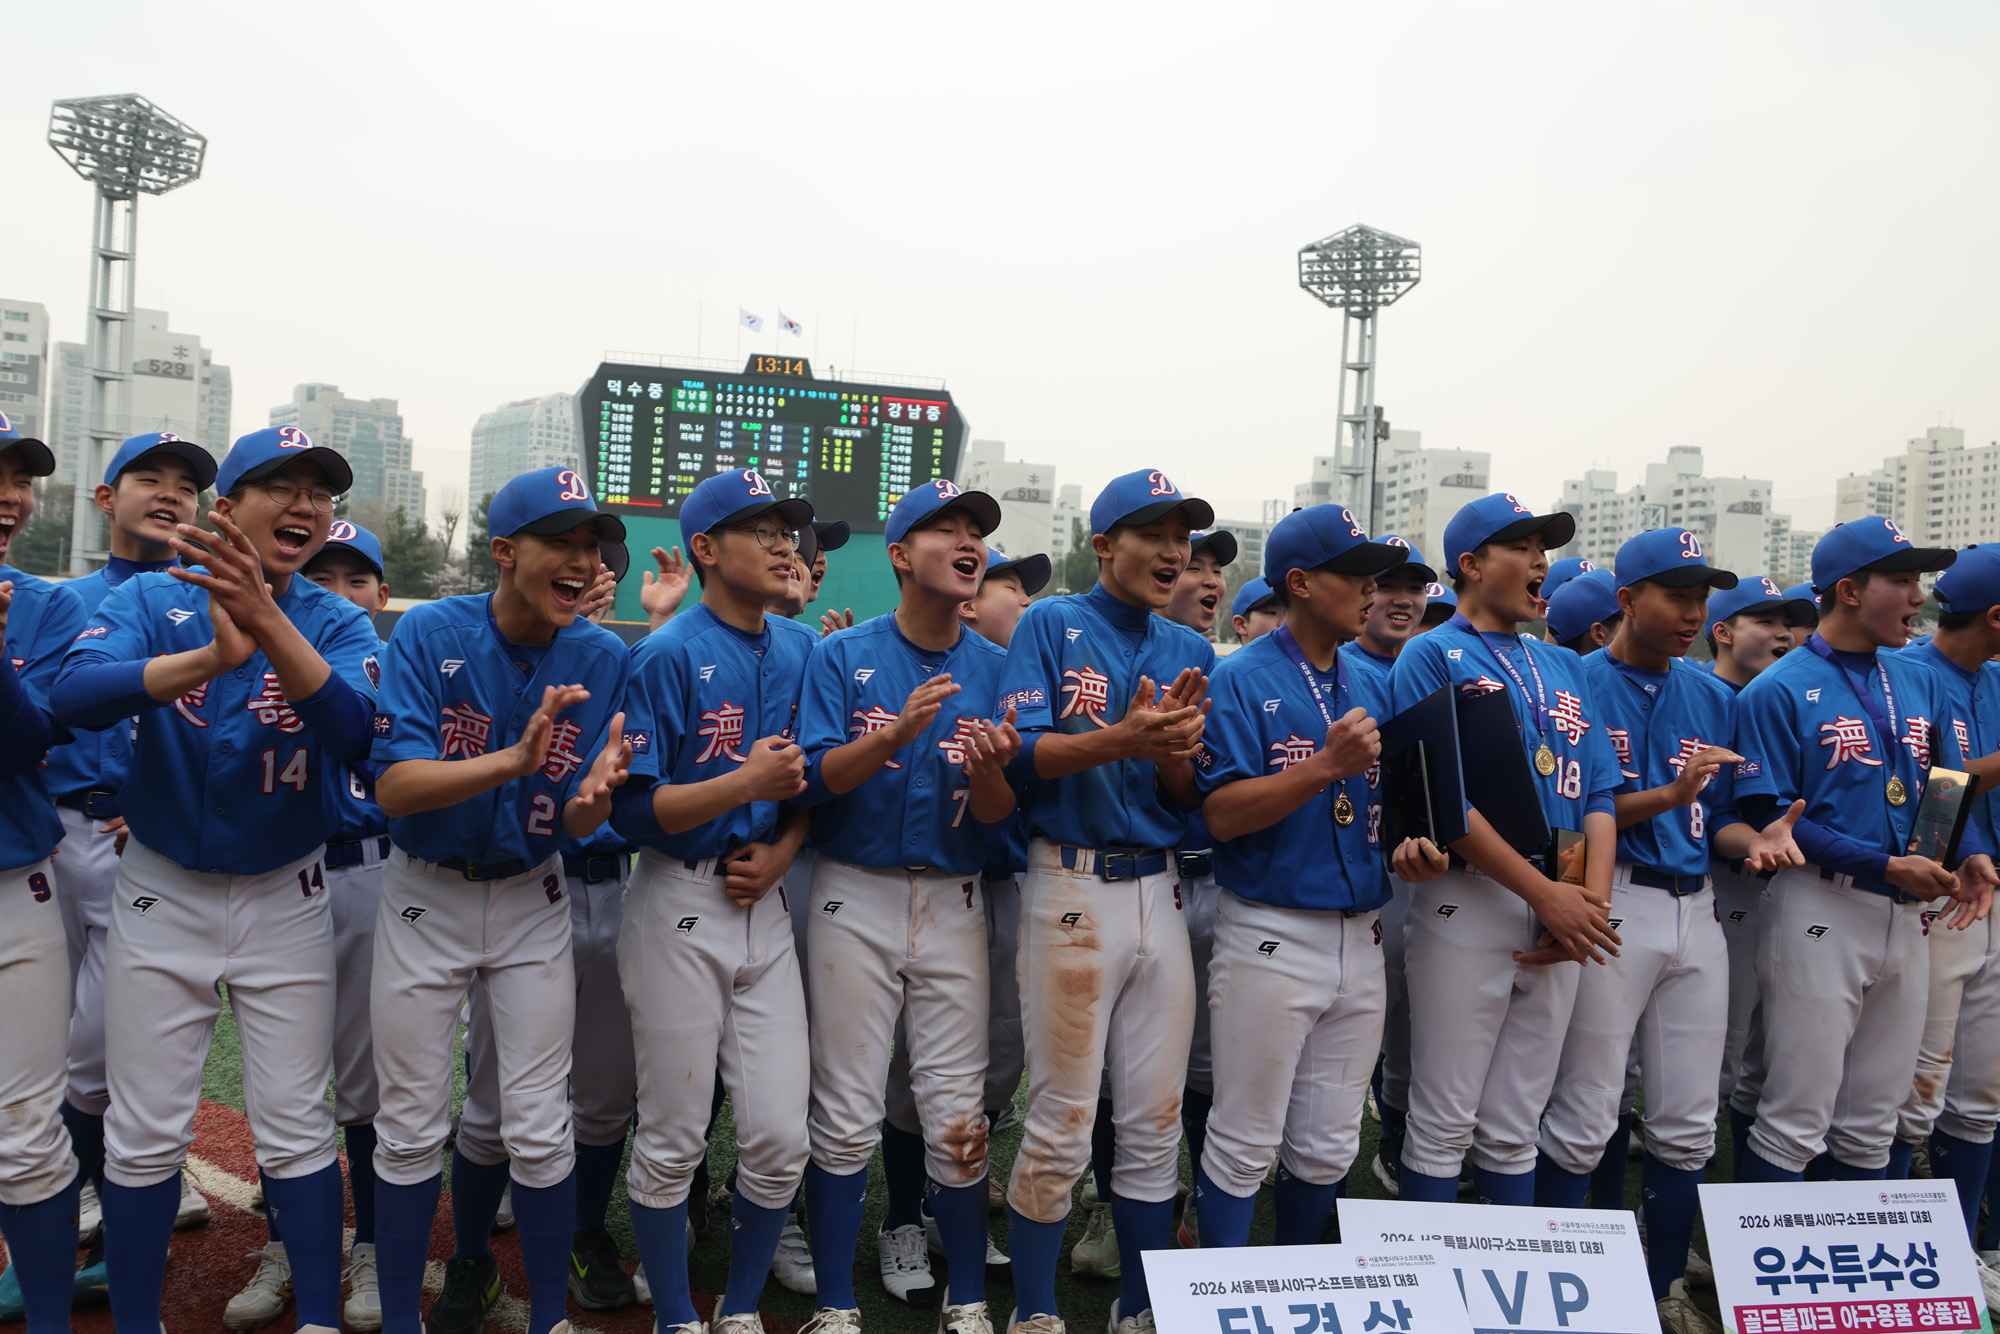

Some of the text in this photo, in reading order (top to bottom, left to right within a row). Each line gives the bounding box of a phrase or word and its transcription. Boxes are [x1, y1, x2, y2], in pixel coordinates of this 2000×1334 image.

[149, 360, 186, 375] 529
[756, 356, 804, 375] 13:14
[607, 380, 663, 399] 덕수중
[682, 380, 705, 389] TEAM
[654, 406, 665, 414] CF
[716, 393, 723, 402] 0
[726, 394, 734, 403] 2
[737, 395, 744, 404] 2
[747, 395, 754, 405] 0
[757, 396, 765, 405] 0
[767, 397, 775, 406] 0
[778, 398, 785, 407] 0
[841, 403, 849, 412] 4
[850, 404, 861, 413] 10
[862, 405, 869, 413] 3
[871, 406, 879, 414] 4
[715, 405, 723, 414] 0
[726, 406, 733, 415] 0
[736, 407, 744, 416] 2
[746, 407, 754, 417] 4
[757, 408, 764, 417] 2
[767, 409, 774, 418] 0
[840, 415, 848, 424] 8
[850, 416, 858, 425] 8
[861, 416, 868, 426] 3
[871, 417, 878, 427] 5
[887, 403, 941, 422] 강남중
[654, 416, 664, 424] SS
[741, 422, 762, 430] 0.200
[679, 423, 705, 432] NO. 14
[653, 437, 664, 445] 1B
[652, 447, 661, 455] LF
[678, 452, 703, 461] NO. 52
[652, 457, 664, 465] DH
[748, 457, 759, 465] 42
[766, 458, 808, 469] BALL 18
[651, 467, 662, 475] 3B
[797, 470, 808, 478] 24
[651, 477, 661, 485] 2B
[789, 482, 798, 492] H
[1456, 474, 1473, 486] 511
[650, 487, 661, 495] RF
[1018, 487, 1040, 500] 513
[1743, 501, 1762, 512] 510
[261, 748, 309, 794] 14
[1557, 754, 1582, 800] 18
[526, 793, 557, 836] 2
[950, 788, 970, 829] 7
[1690, 800, 1705, 839] 8
[27, 871, 52, 903] 9
[298, 862, 326, 898] 14
[542, 873, 562, 905] 2
[962, 881, 974, 909] 7
[1739, 1210, 1932, 1228] 2026 서울특별시야구소프트볼협회 대회
[1580, 1241, 1605, 1254] 대회
[1753, 1241, 1941, 1296] 우수투수상
[1190, 1273, 1419, 1296] 2026 서울특별시야구소프트볼협회 대회
[1453, 1268, 1589, 1327] VP
[1742, 1301, 1972, 1334] 골드볼파크 야구용품 상품권
